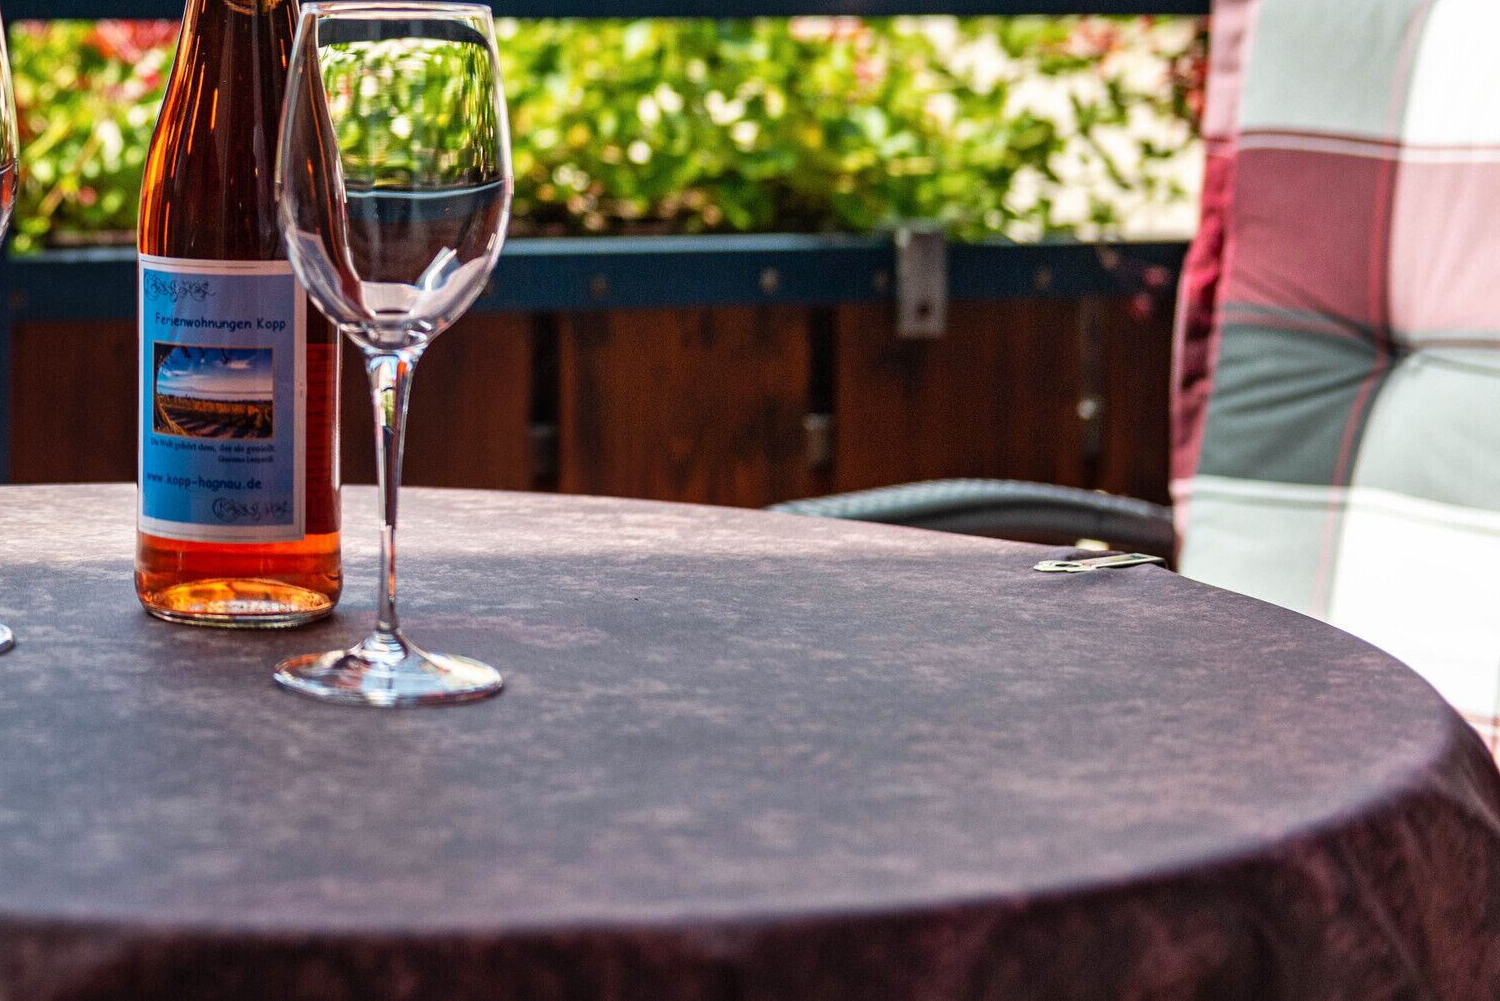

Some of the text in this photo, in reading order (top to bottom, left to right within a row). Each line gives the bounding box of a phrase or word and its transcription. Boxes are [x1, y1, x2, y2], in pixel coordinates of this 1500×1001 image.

[155, 312, 286, 332] Ferienwohnungen Kopp
[147, 473, 261, 491] www.kopp-hagnau.de
